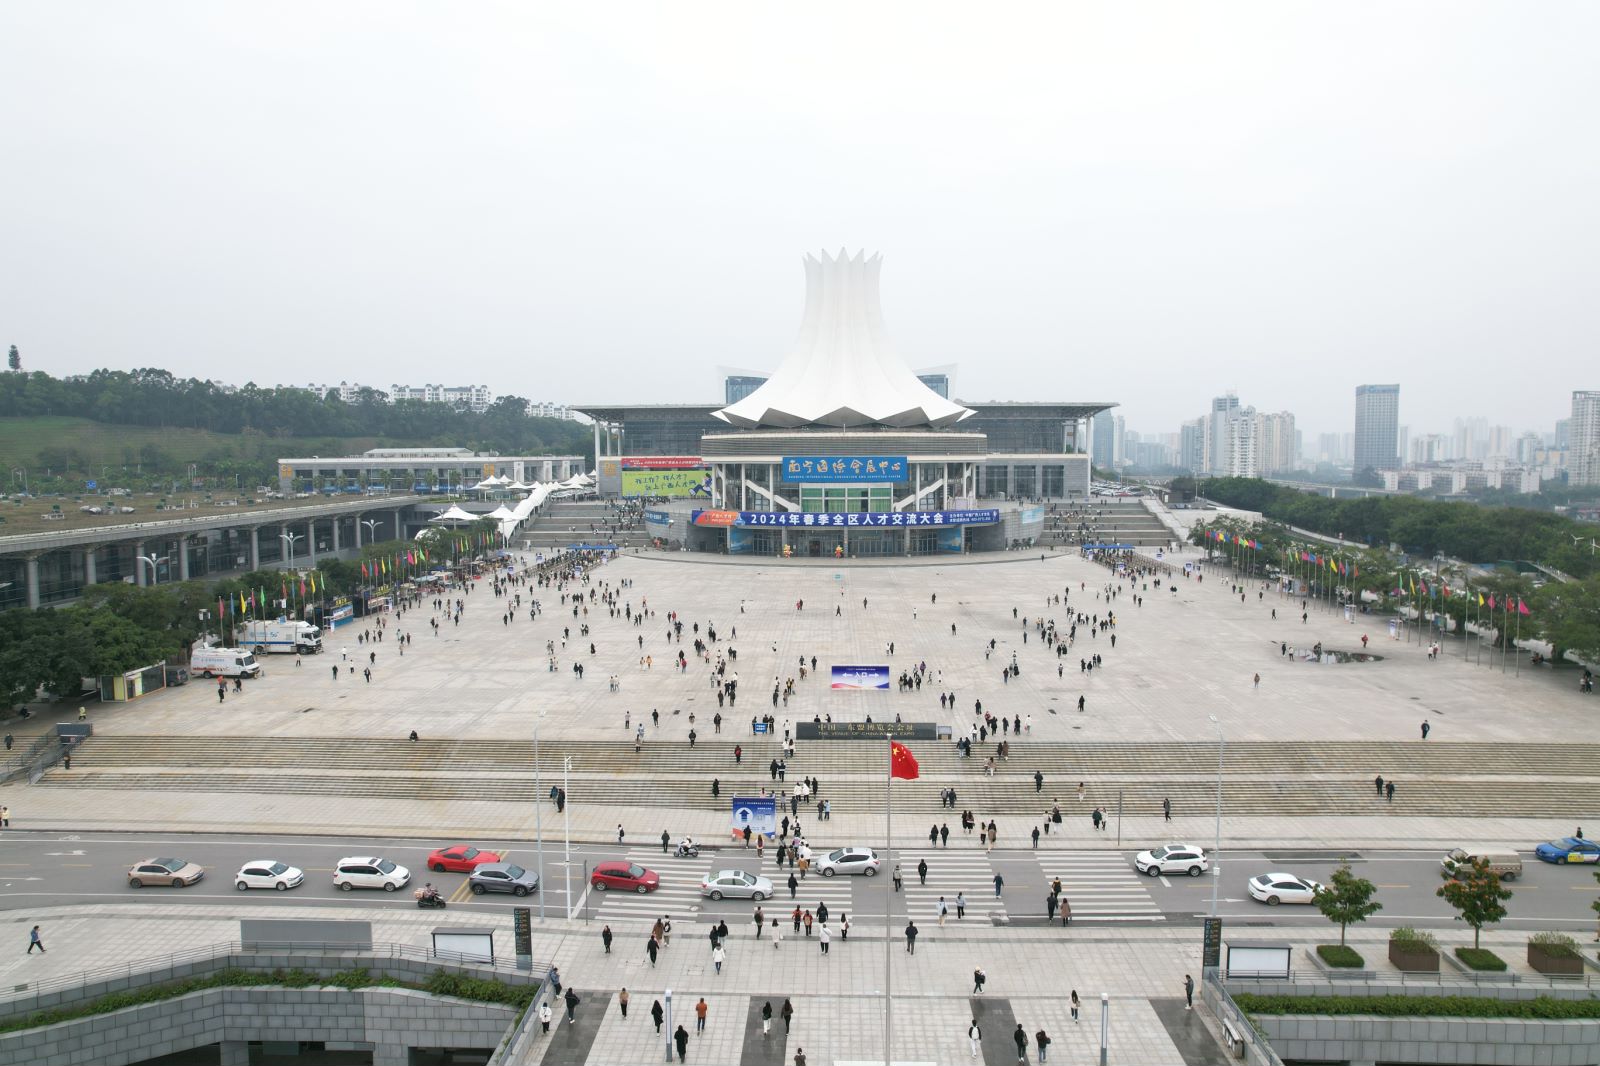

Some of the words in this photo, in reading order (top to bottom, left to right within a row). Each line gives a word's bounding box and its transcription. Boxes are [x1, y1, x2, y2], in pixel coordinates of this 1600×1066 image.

[751, 512, 944, 526] 2024年春季全区人才交流大会
